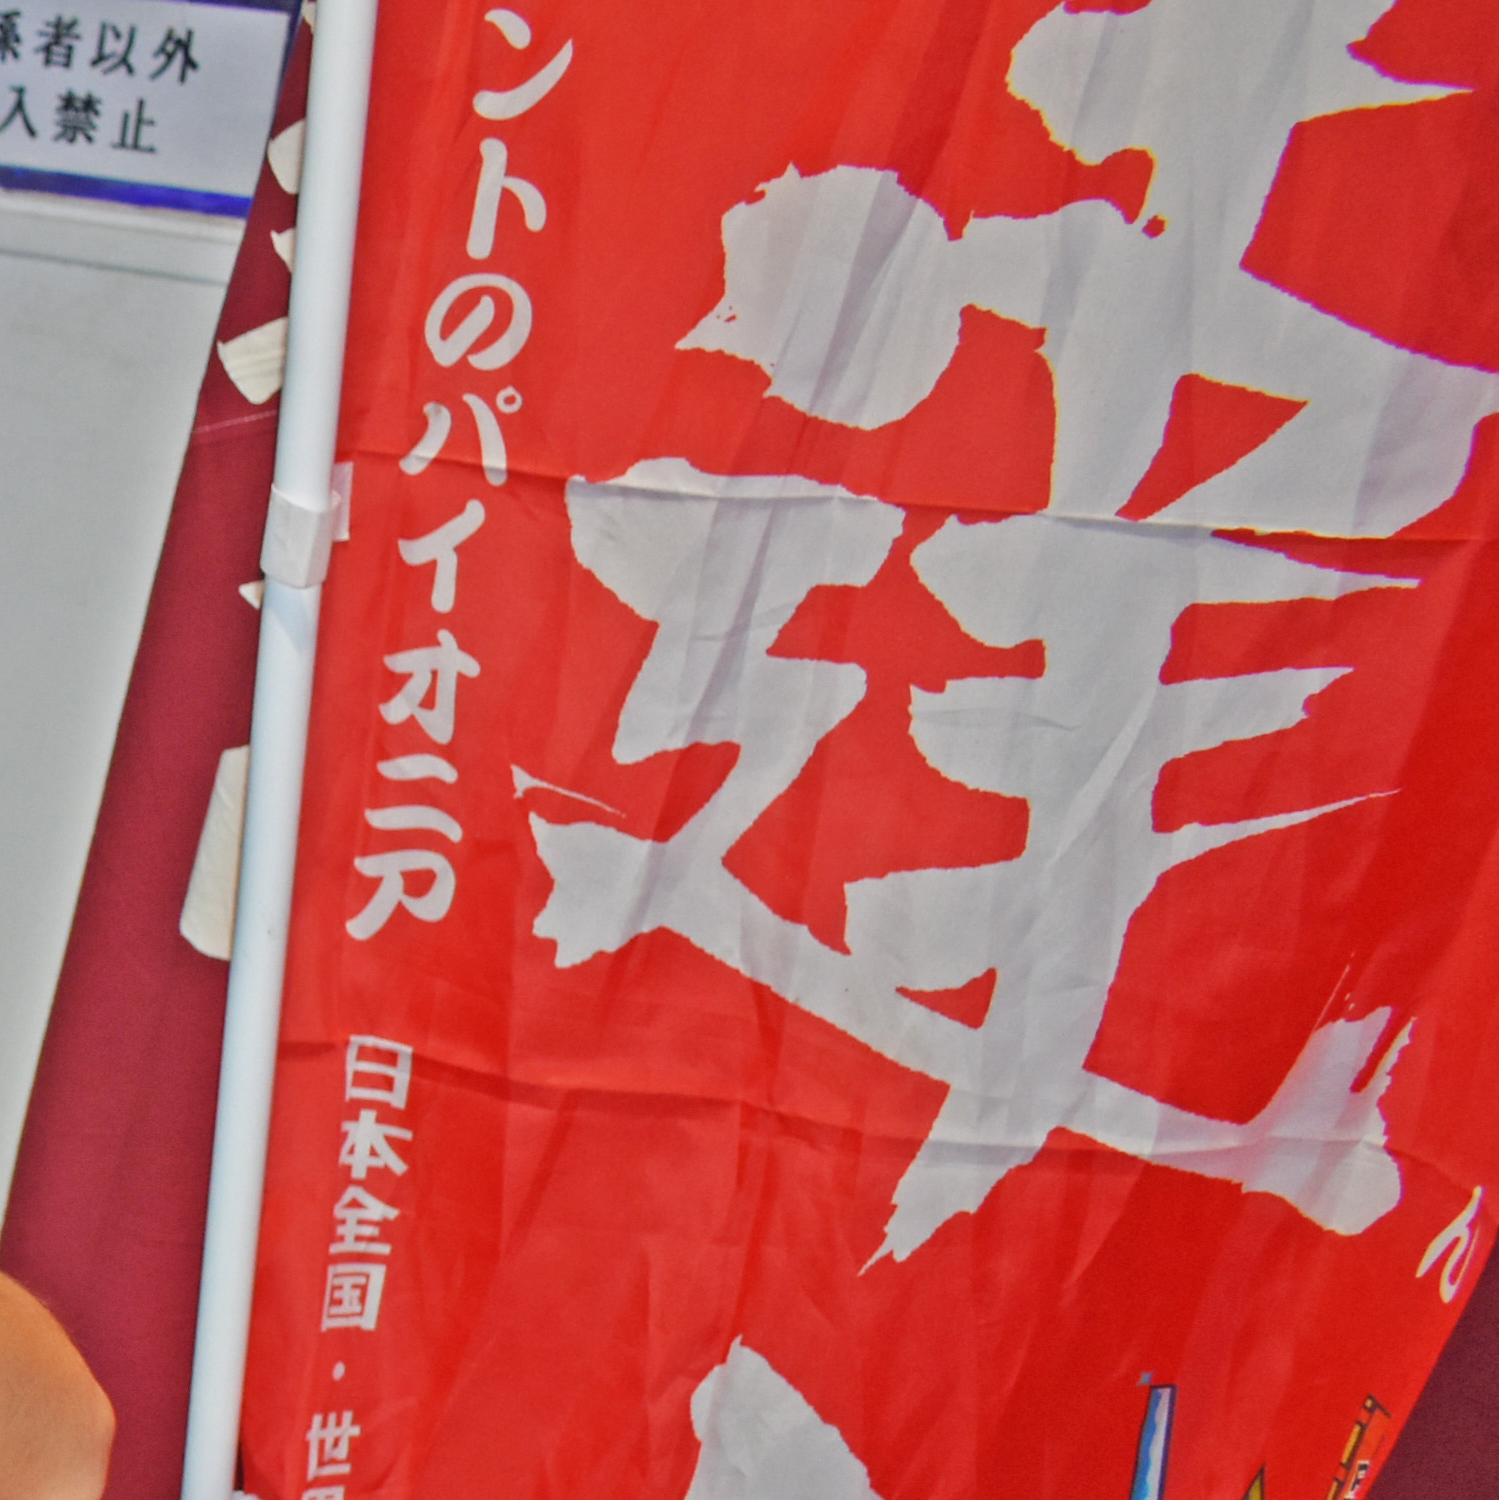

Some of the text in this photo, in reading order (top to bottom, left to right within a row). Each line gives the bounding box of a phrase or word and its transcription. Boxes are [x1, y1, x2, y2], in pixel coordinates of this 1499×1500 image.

[345, 8, 573, 941] ントのパイオニア
